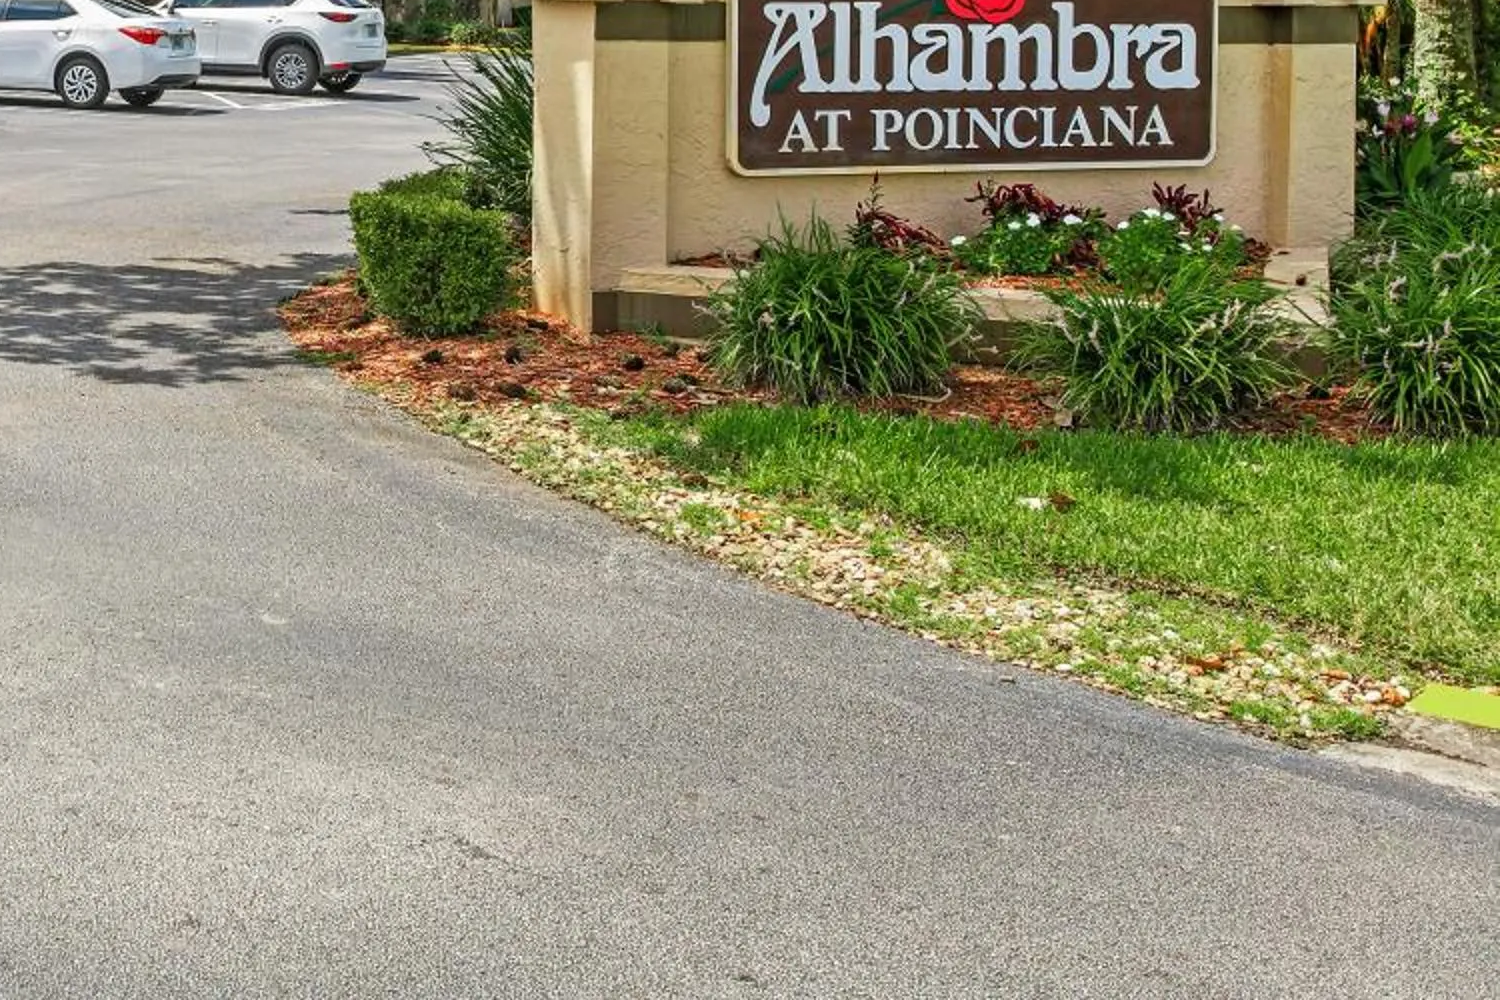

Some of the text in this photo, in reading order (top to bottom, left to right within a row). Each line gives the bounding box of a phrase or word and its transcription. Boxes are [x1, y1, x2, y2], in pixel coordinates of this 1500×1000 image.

[751, 1, 1200, 127] Alhambra
[778, 103, 1174, 153] AT POINCIANA
